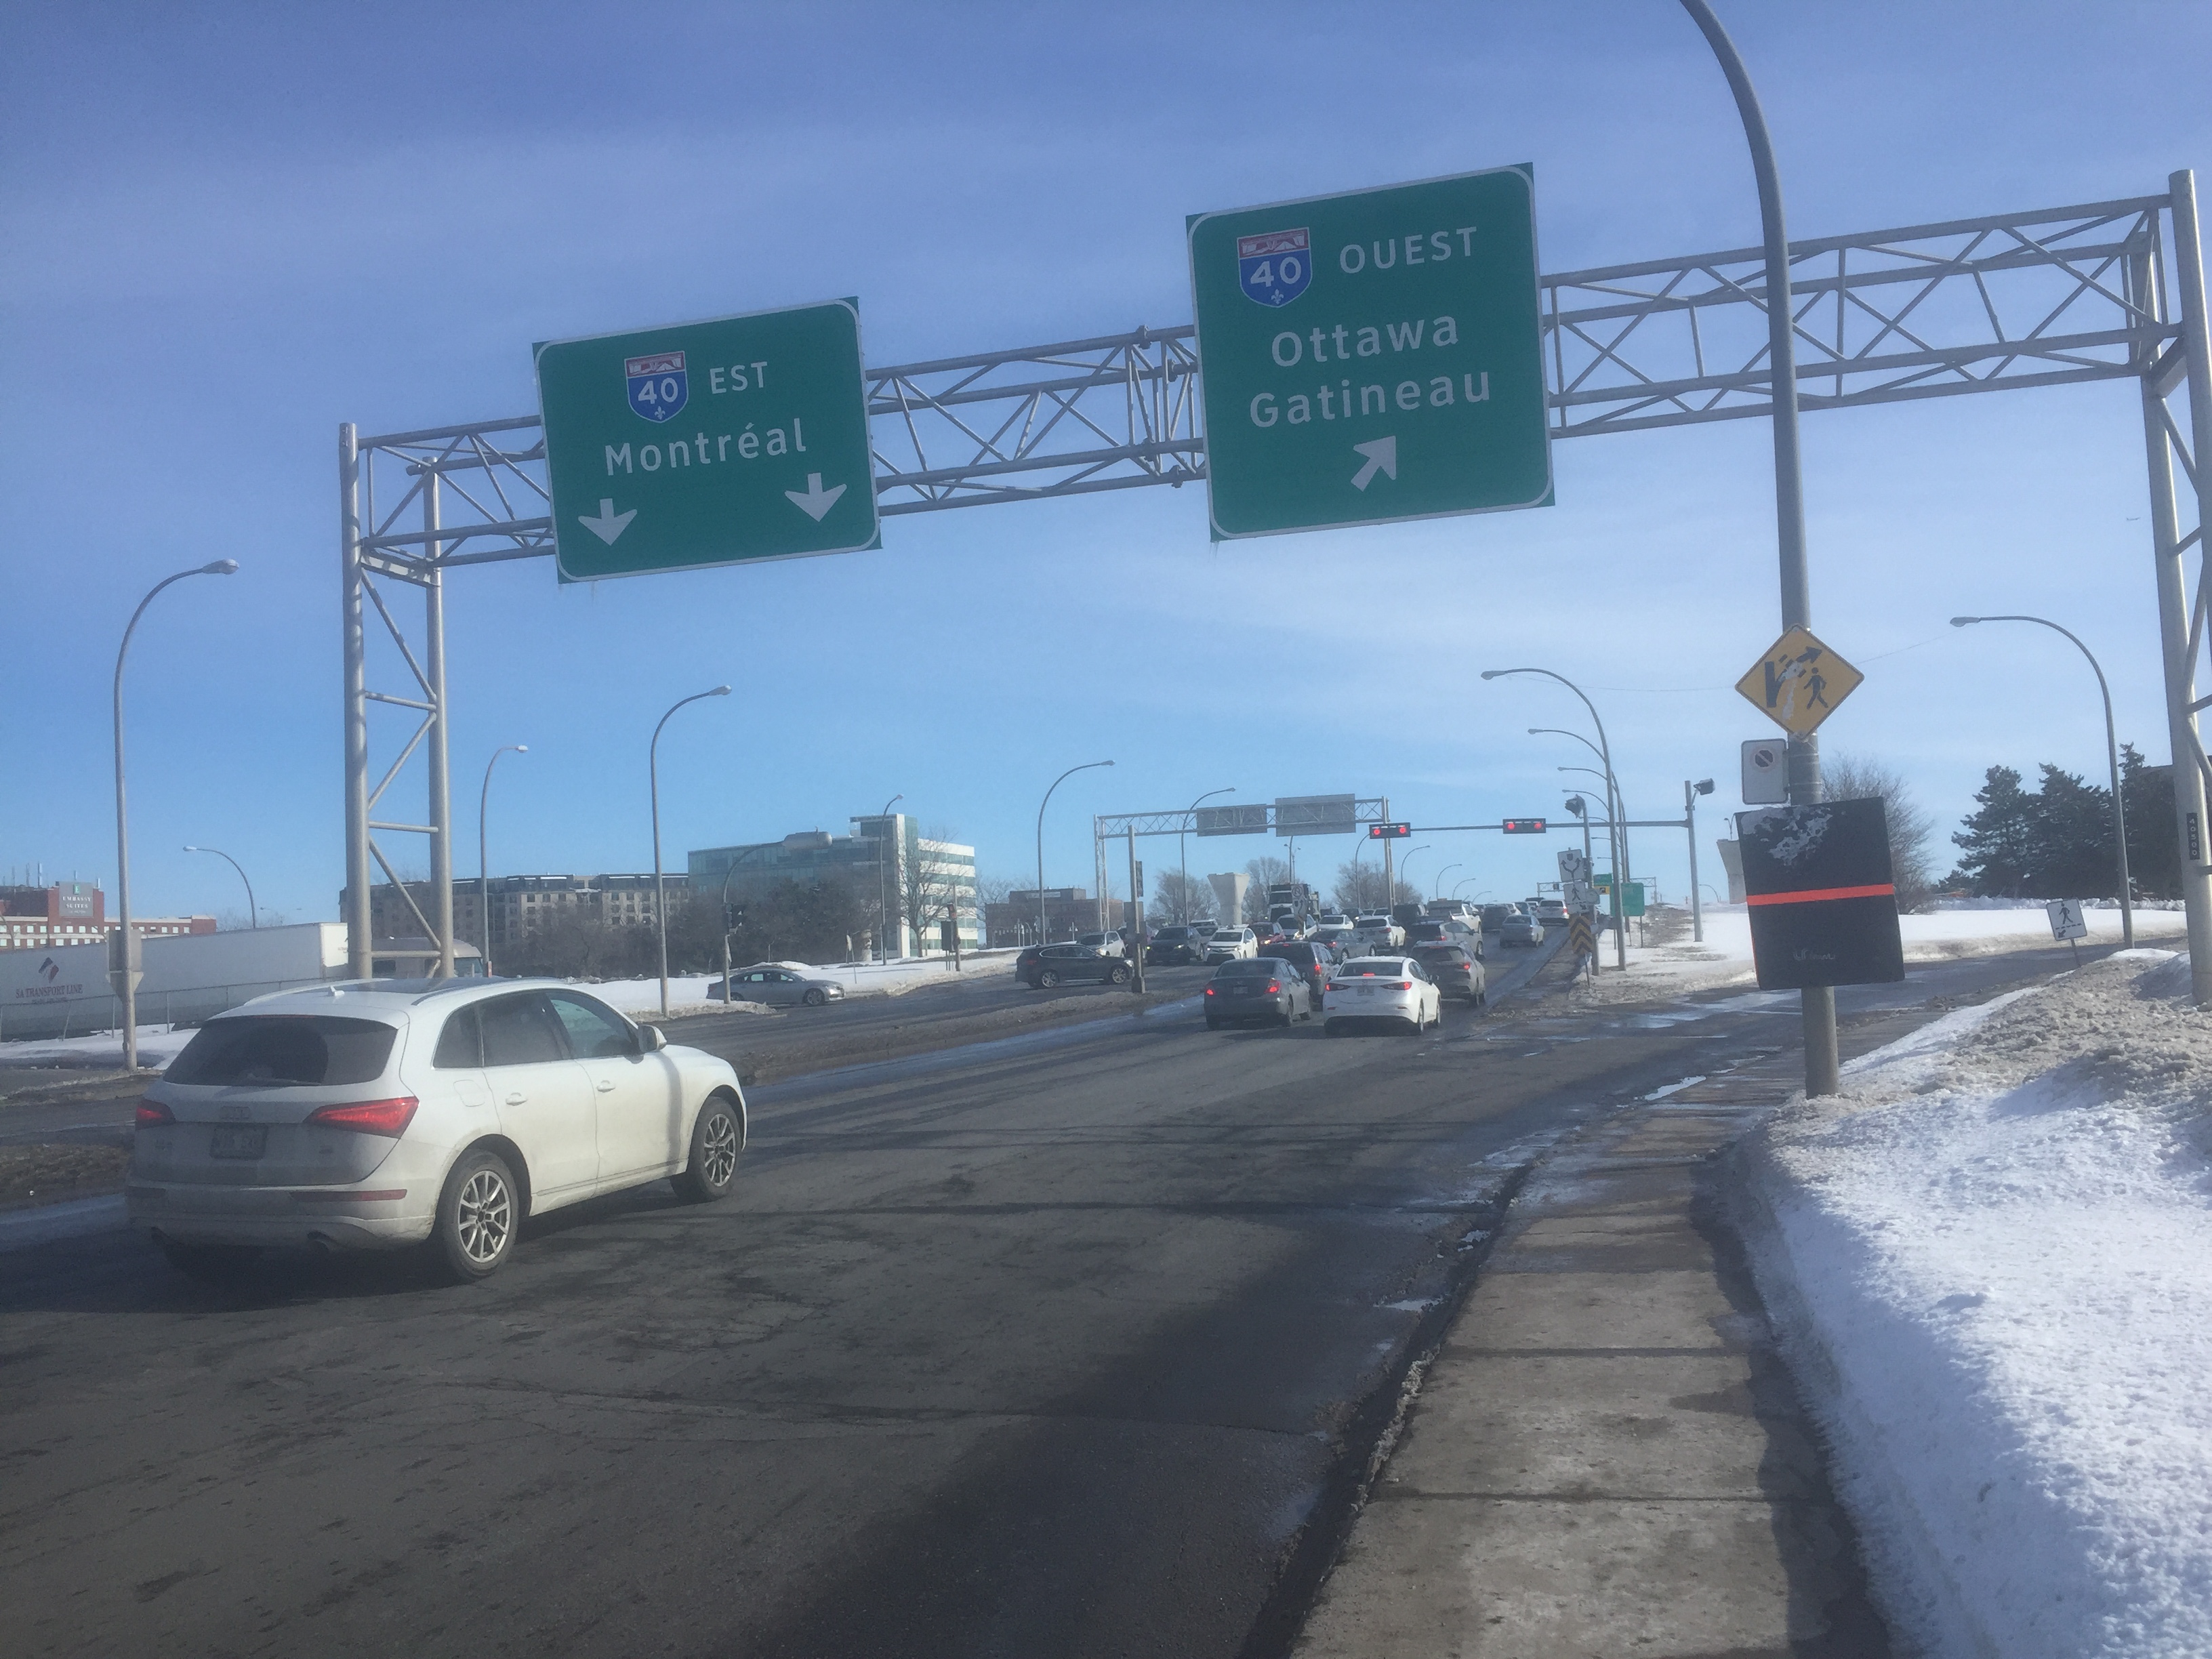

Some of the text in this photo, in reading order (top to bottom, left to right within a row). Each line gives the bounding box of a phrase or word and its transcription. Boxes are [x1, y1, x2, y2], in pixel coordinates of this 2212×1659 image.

[1250, 226, 1477, 287] 40 OUEST
[1272, 316, 1458, 367] Ottawa
[638, 361, 767, 404] 40 EST
[1250, 371, 1490, 427] Gatineau
[605, 418, 806, 476] Montréal
[26, 985, 65, 998] TRANSPORT
[66, 984, 83, 994] LINE
